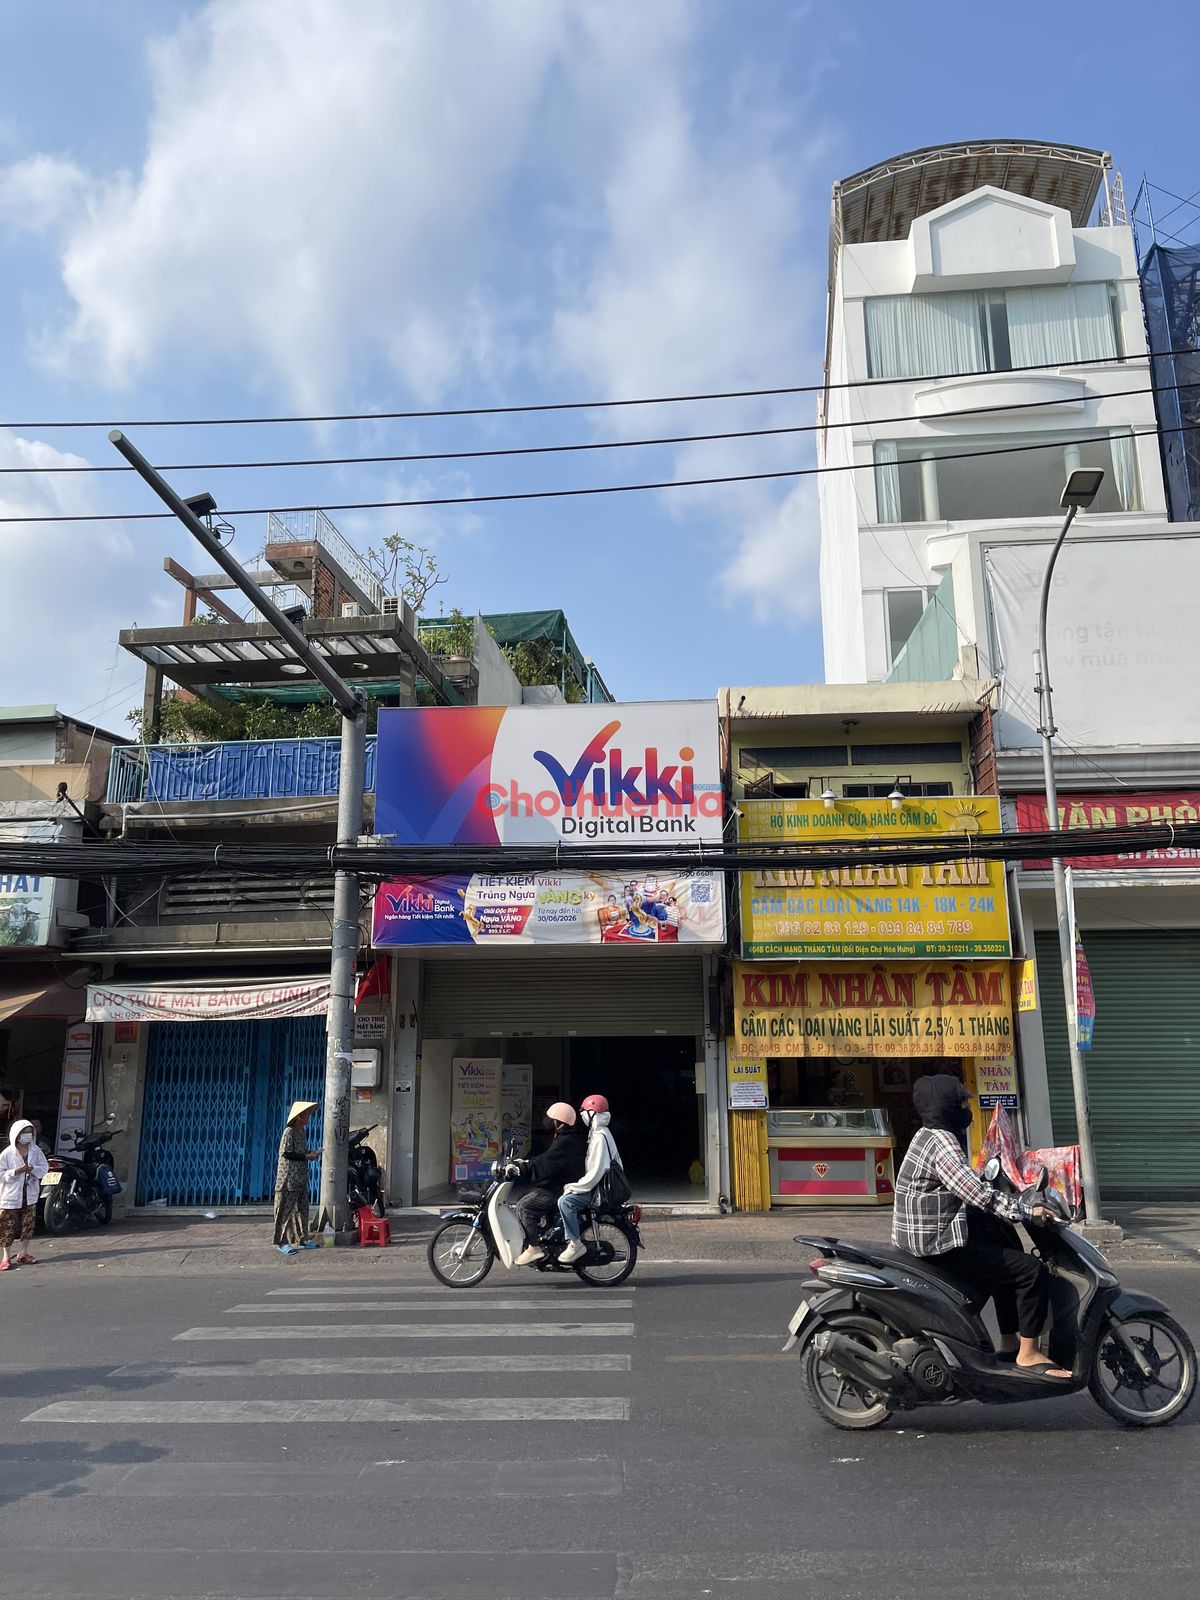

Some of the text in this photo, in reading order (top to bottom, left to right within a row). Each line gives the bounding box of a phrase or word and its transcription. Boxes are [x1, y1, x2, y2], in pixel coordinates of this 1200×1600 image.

[533, 720, 695, 807] Vikki
[770, 812, 783, 831] HỘ
[786, 814, 809, 828] KINH
[812, 813, 845, 827] DOANH
[870, 810, 896, 826] HÀNG
[1125, 799, 1200, 826] PHÒ
[561, 815, 696, 838] Digital Bank
[537, 878, 561, 886] Vikki
[386, 885, 434, 913] Vikki
[477, 890, 506, 901] Trúng
[509, 890, 535, 901] Ngựa
[434, 904, 455, 912] Bank
[897, 897, 921, 913] 14K
[933, 896, 957, 912] 18K
[968, 896, 995, 912] 24K
[537, 915, 577, 923] 30/06/2026
[803, 921, 821, 935] 82
[823, 921, 841, 935] 83
[844, 921, 869, 935] 129
[878, 920, 903, 935] 093
[906, 920, 924, 935] 84
[927, 920, 944, 935] 84
[947, 919, 973, 935] 789
[938, 944, 969, 953] 39.310211
[974, 944, 1006, 953] 39.350221
[742, 962, 1005, 1007] KIM NHÂN TÂM
[93, 992, 125, 1007] CHO
[127, 991, 166, 1009] THUÊ
[741, 1010, 1010, 1041] CẦM CÁC LOẠI VÀNG LÃI SUẤT 2,5% 1 THÁNG
[459, 1062, 484, 1076] Vikki
[980, 1065, 1011, 1076] NHÂN
[983, 1079, 1009, 1091] TÂM
